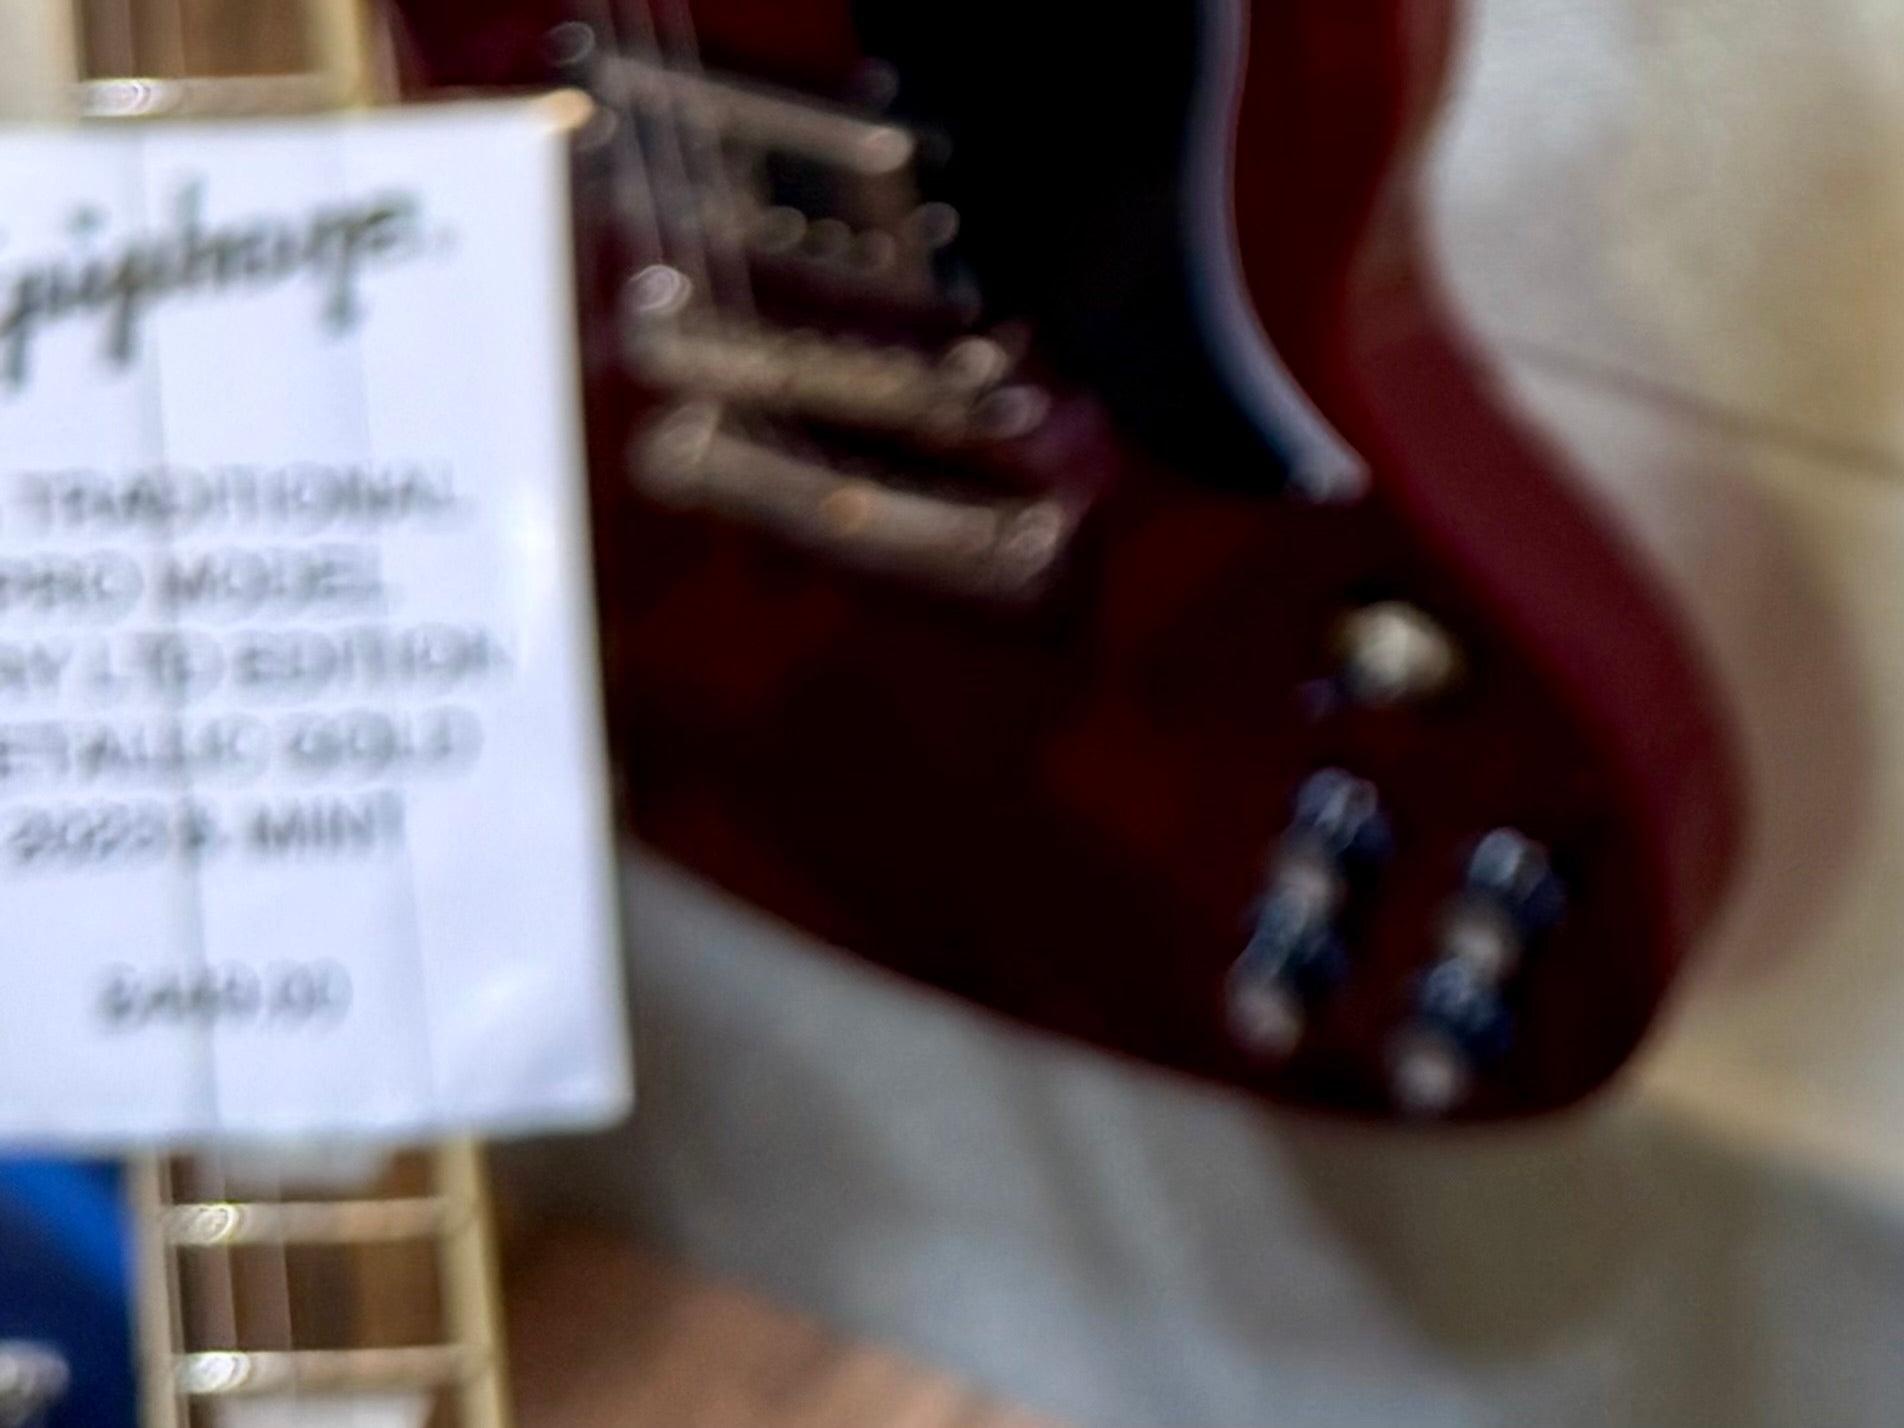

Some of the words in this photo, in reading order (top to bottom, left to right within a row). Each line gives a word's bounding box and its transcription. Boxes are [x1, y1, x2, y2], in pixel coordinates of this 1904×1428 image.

[0, 169, 462, 392] piphone.
[12, 466, 476, 536] TRADITIONAL
[232, 624, 516, 700] EDITION
[0, 718, 270, 790] ETALLIC
